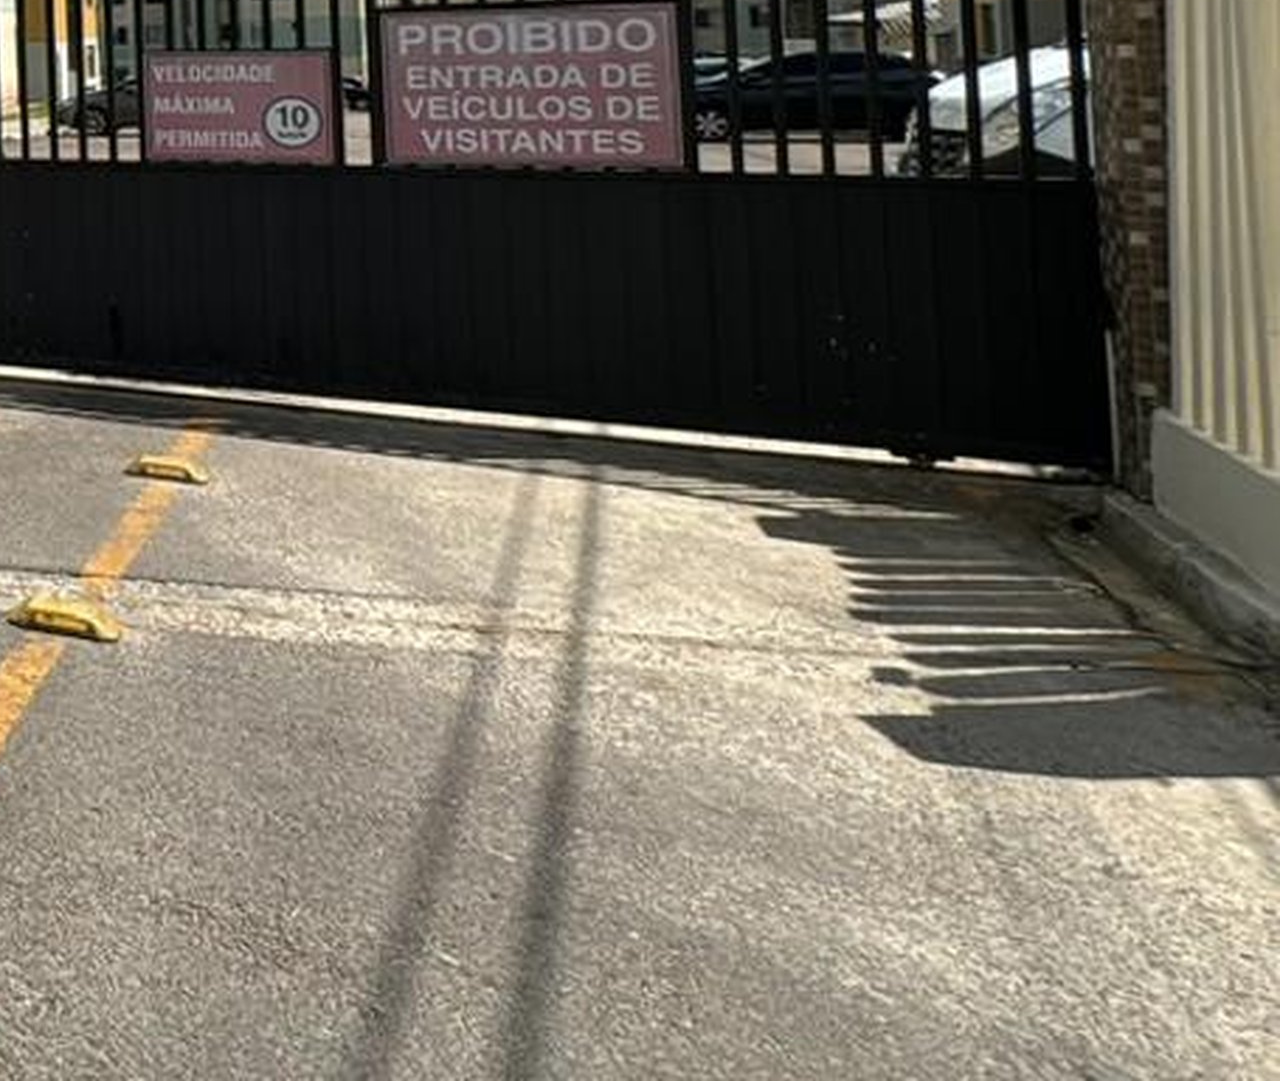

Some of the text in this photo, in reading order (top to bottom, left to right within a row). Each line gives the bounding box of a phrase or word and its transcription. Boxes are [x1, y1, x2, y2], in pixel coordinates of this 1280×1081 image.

[398, 18, 657, 55] PROIBIDO
[151, 63, 277, 83] VELOCIDADE
[406, 63, 655, 90] ENTRADA DE
[153, 92, 235, 114] MÁXIMA
[402, 90, 660, 121] VEÍCULOS DE
[274, 105, 310, 130] 10
[154, 129, 265, 149] PERMITIDA
[421, 128, 645, 155] VISITANTES
